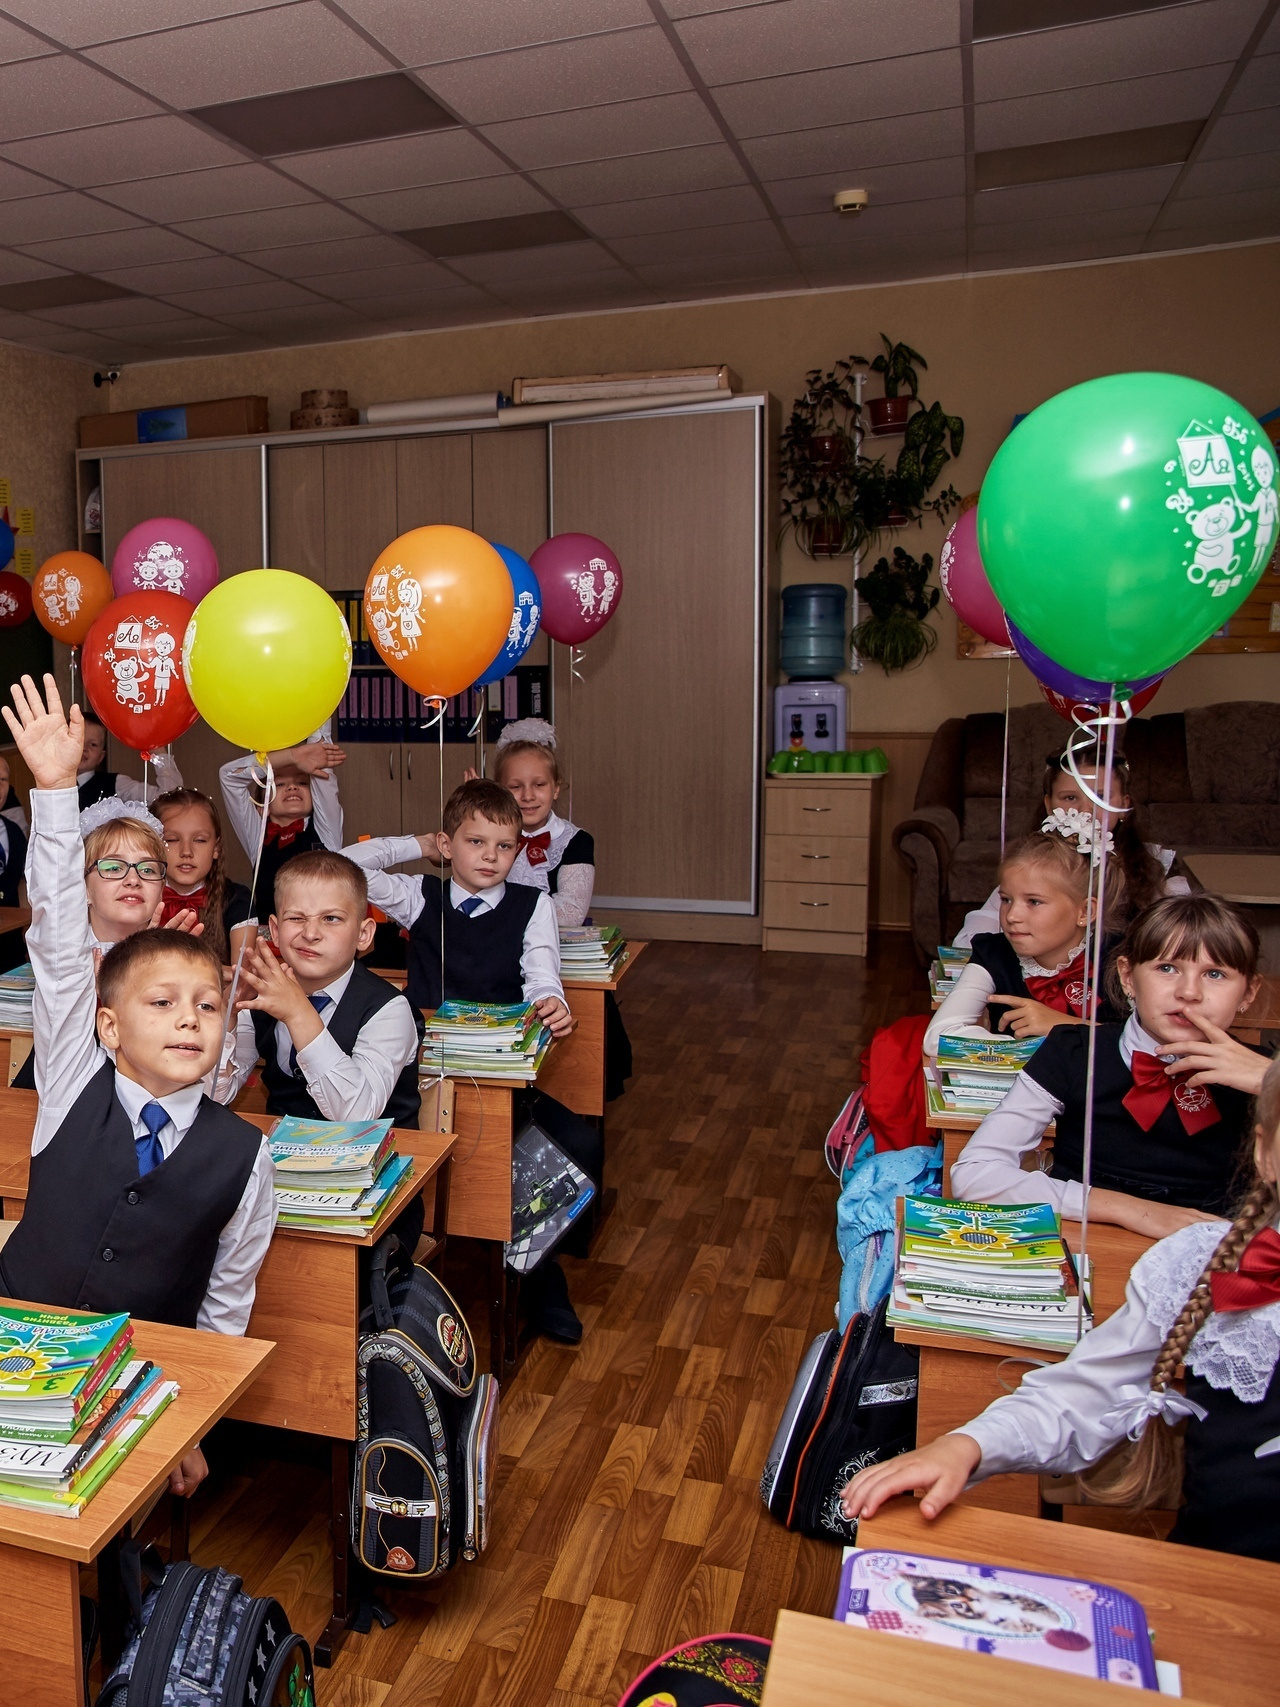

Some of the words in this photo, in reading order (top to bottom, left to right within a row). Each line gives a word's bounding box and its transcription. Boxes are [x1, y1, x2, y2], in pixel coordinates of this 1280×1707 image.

[1028, 1246, 1047, 1255] 3
[22, 1317, 78, 1326] Развитие
[32, 1320, 113, 1336] РУССКИЙ
[42, 1376, 66, 1391] 3
